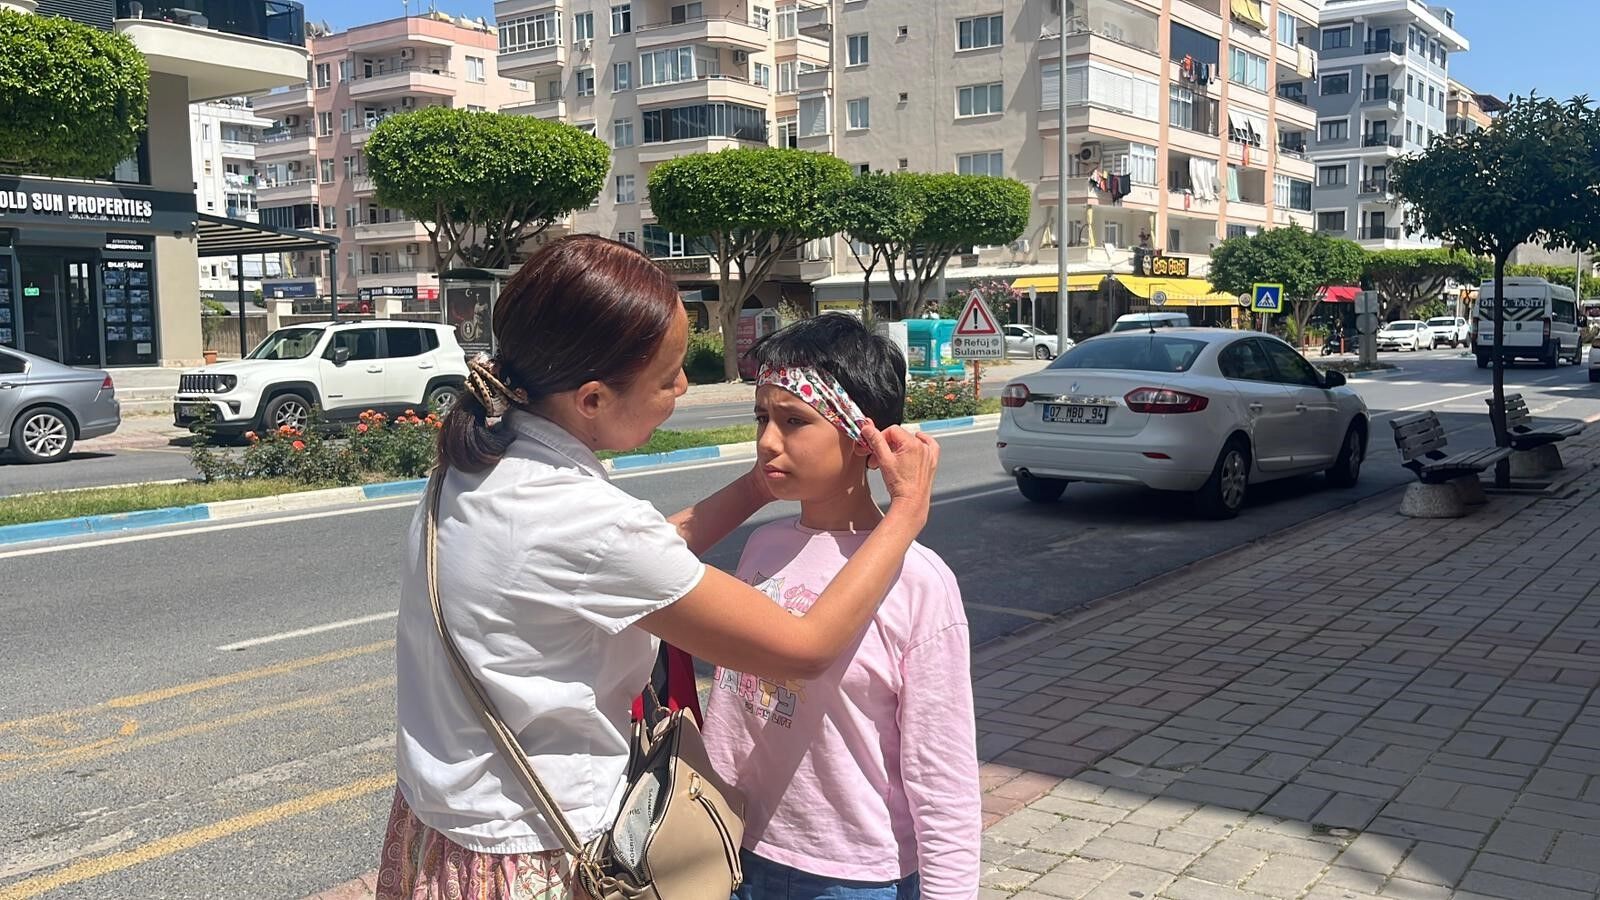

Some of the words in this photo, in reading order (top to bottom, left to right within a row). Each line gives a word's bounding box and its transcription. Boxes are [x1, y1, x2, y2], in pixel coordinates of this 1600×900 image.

[31, 192, 63, 212] SUN
[67, 195, 152, 217] PROPERTIES
[1481, 299, 1508, 307] OKL
[964, 338, 989, 348] Refüj
[954, 348, 1000, 356] Sulaması
[1050, 407, 1061, 417] 07
[1092, 408, 1103, 418] 94
[756, 709, 770, 720] MY
[771, 713, 792, 728] LIFE
